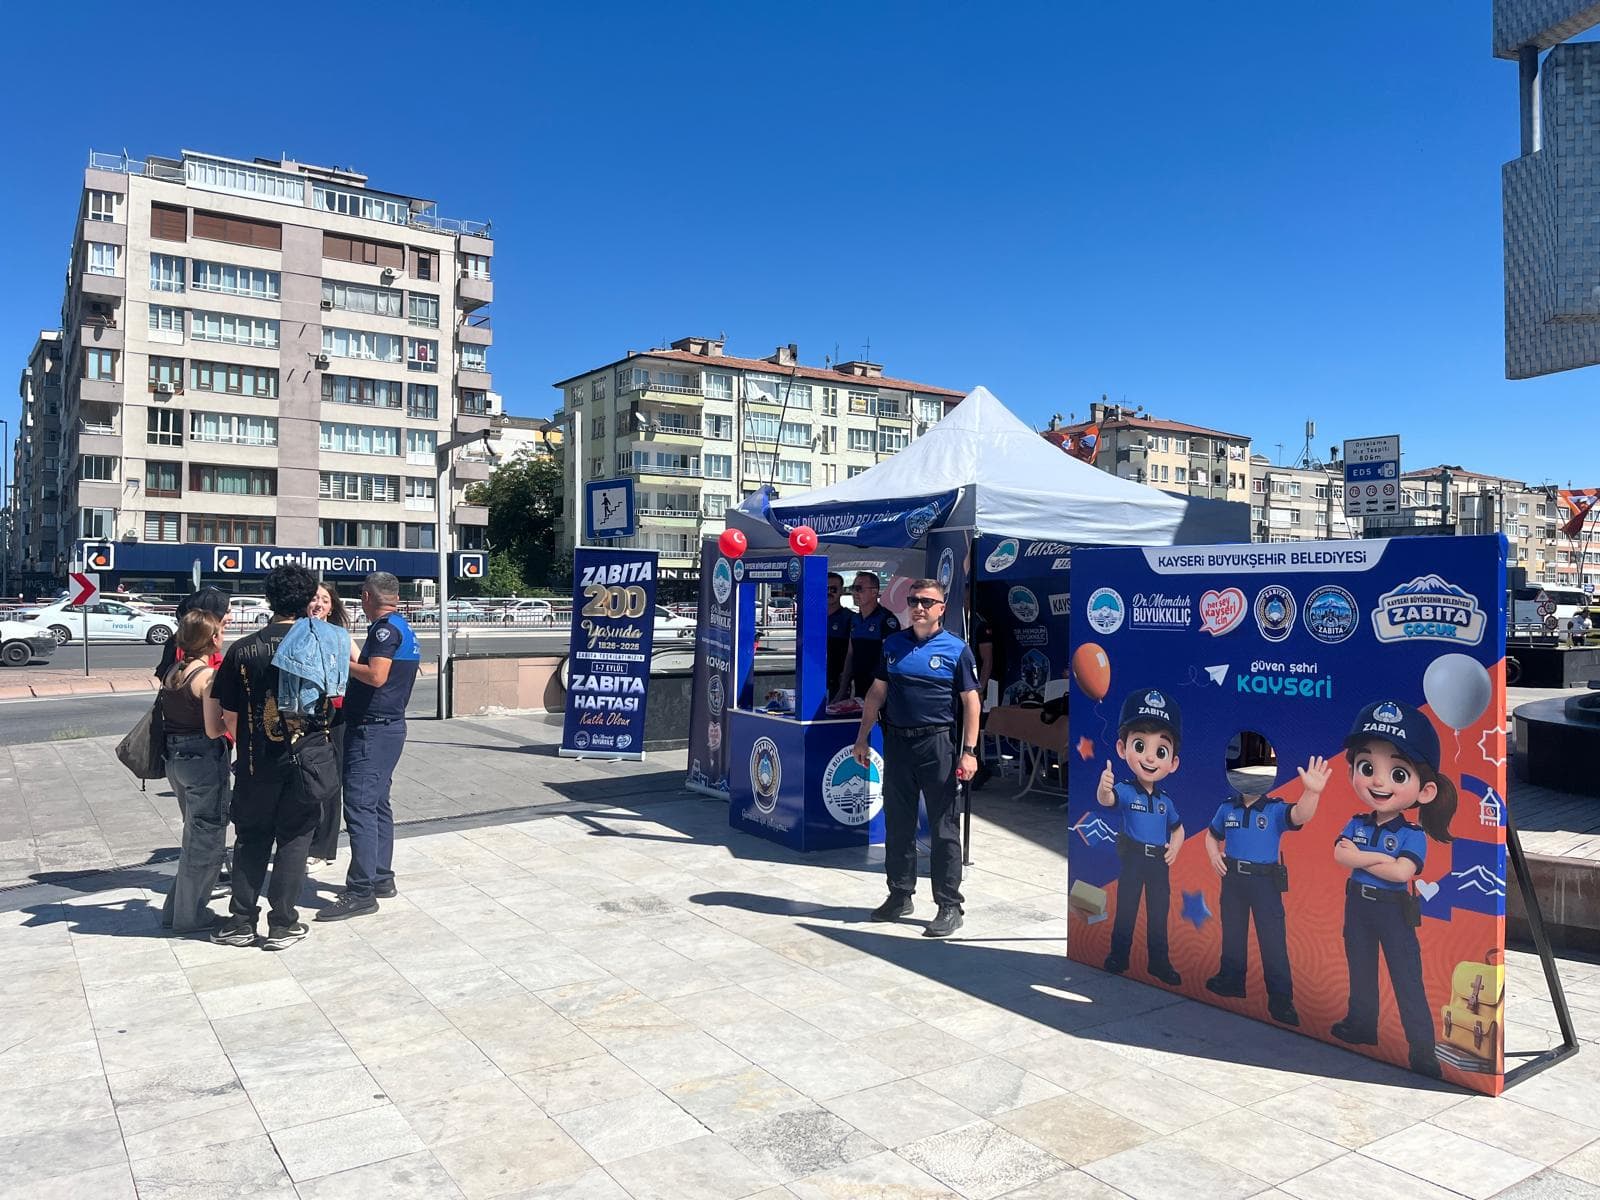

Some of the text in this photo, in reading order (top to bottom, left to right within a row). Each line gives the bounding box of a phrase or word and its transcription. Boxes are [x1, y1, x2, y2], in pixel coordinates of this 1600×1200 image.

[1352, 468, 1372, 476] EDS
[255, 551, 377, 571] Katılımevim
[1208, 553, 1286, 568] BÜYÜKŞEHİR
[580, 561, 652, 587] ZABITA
[582, 584, 647, 618] 200
[1148, 593, 1191, 608] Memduh
[1392, 606, 1468, 625] ZABITA
[581, 619, 643, 649] Yaşında
[1318, 626, 1344, 634] ZABITA
[1403, 623, 1457, 638] ÇOCUK
[1250, 660, 1318, 675] güven şehri
[571, 674, 645, 694] ZABITA
[1237, 674, 1332, 699] kayseri
[574, 695, 639, 711] HAFTASI
[1138, 706, 1170, 721] ZABITA
[1362, 722, 1407, 739] ZABITA
[848, 815, 865, 823] 1869
